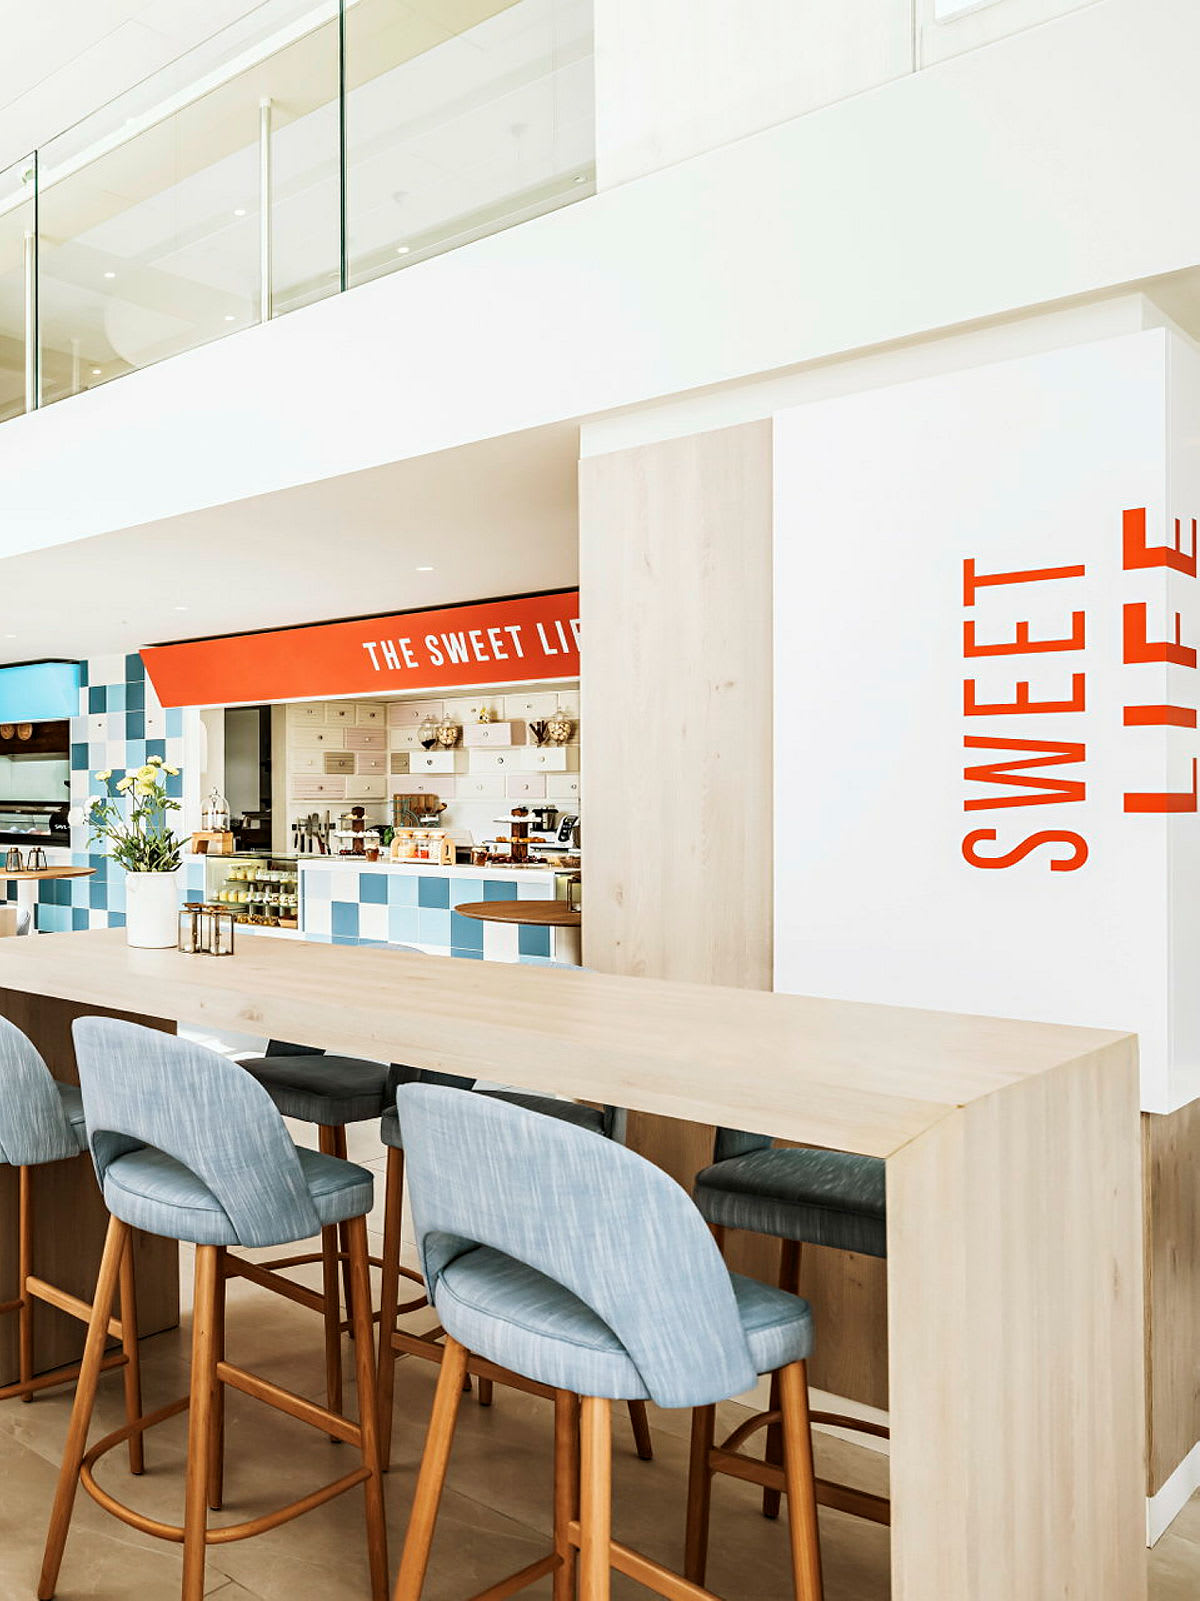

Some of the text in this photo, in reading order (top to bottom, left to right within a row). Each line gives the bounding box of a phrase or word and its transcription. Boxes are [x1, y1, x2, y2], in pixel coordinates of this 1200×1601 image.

[362, 638, 419, 671] THE
[424, 625, 525, 667] SWEET
[961, 557, 1089, 873] SWEET
[1122, 507, 1197, 813] LIFE
